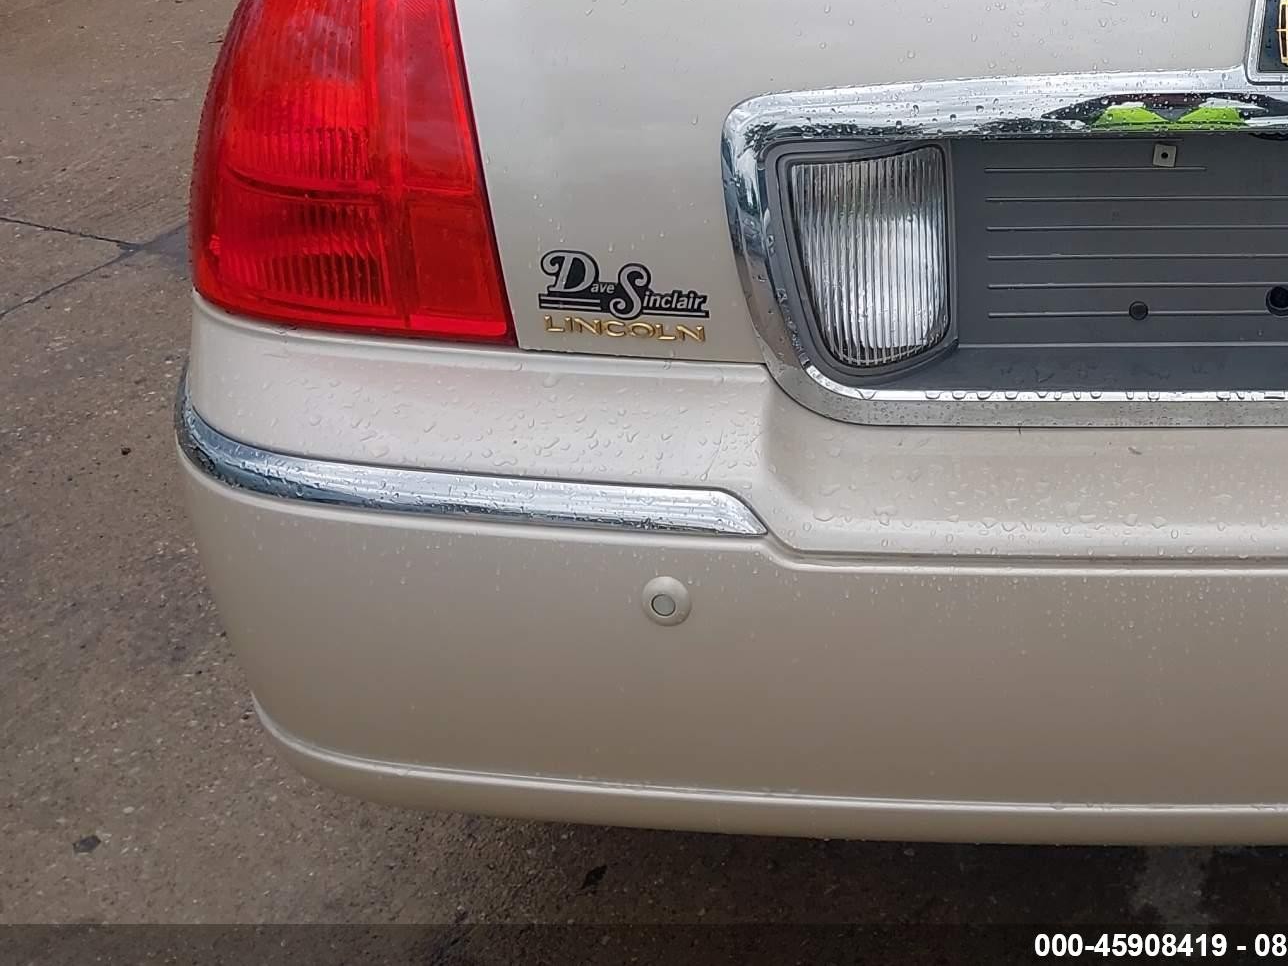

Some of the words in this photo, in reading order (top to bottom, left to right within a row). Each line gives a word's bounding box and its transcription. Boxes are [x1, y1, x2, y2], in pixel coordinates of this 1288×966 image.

[541, 250, 616, 294] Dave
[609, 263, 706, 320] Sinclair
[543, 314, 706, 343] LINCOLN
